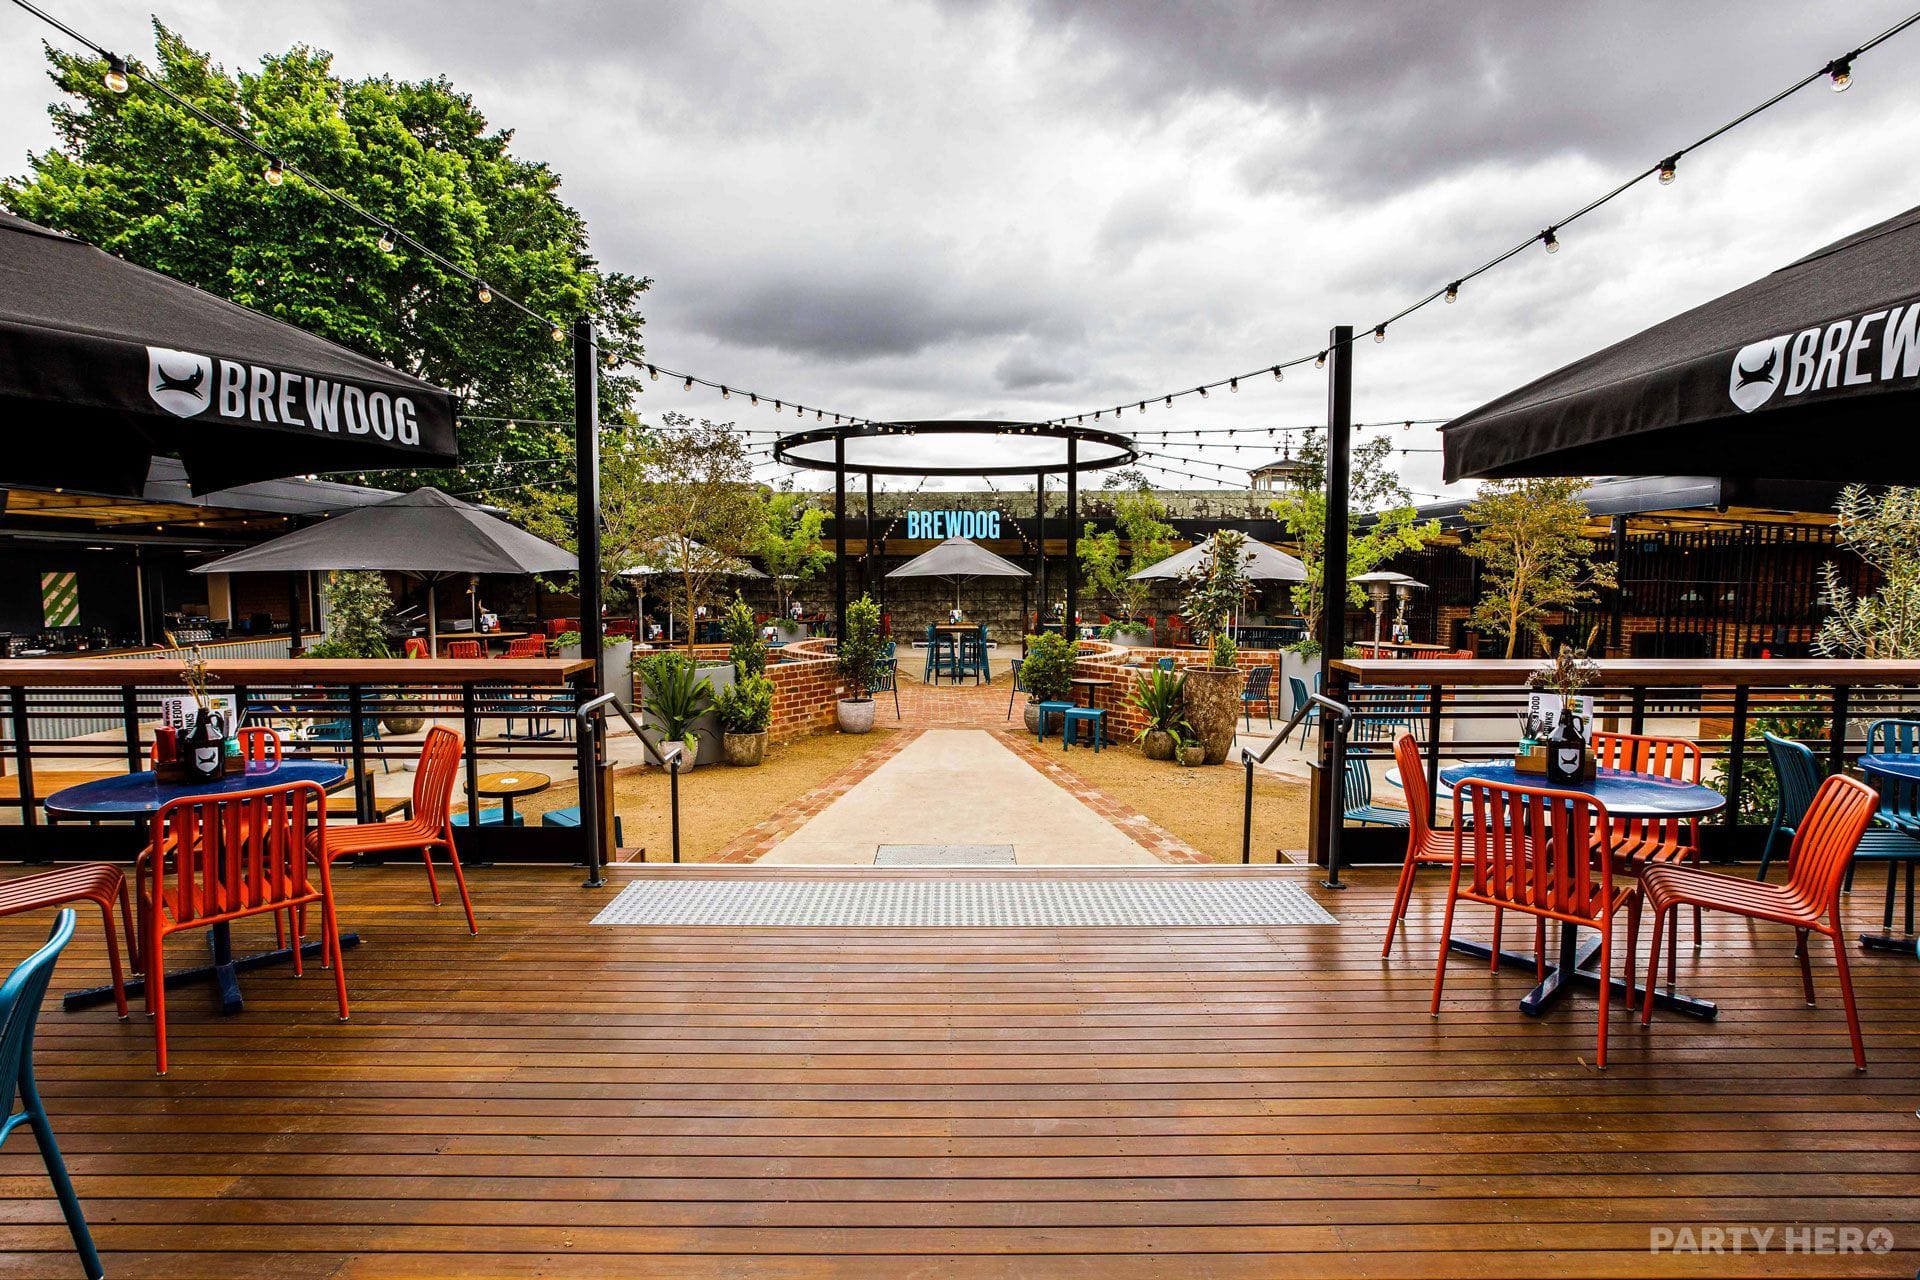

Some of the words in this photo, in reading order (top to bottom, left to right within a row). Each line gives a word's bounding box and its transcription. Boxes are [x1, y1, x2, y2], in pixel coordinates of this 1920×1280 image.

[219, 359, 420, 446] BREWDOG
[907, 510, 1000, 539] BREWDOG
[172, 700, 182, 718] FOOD
[1531, 696, 1540, 714] FOOD
